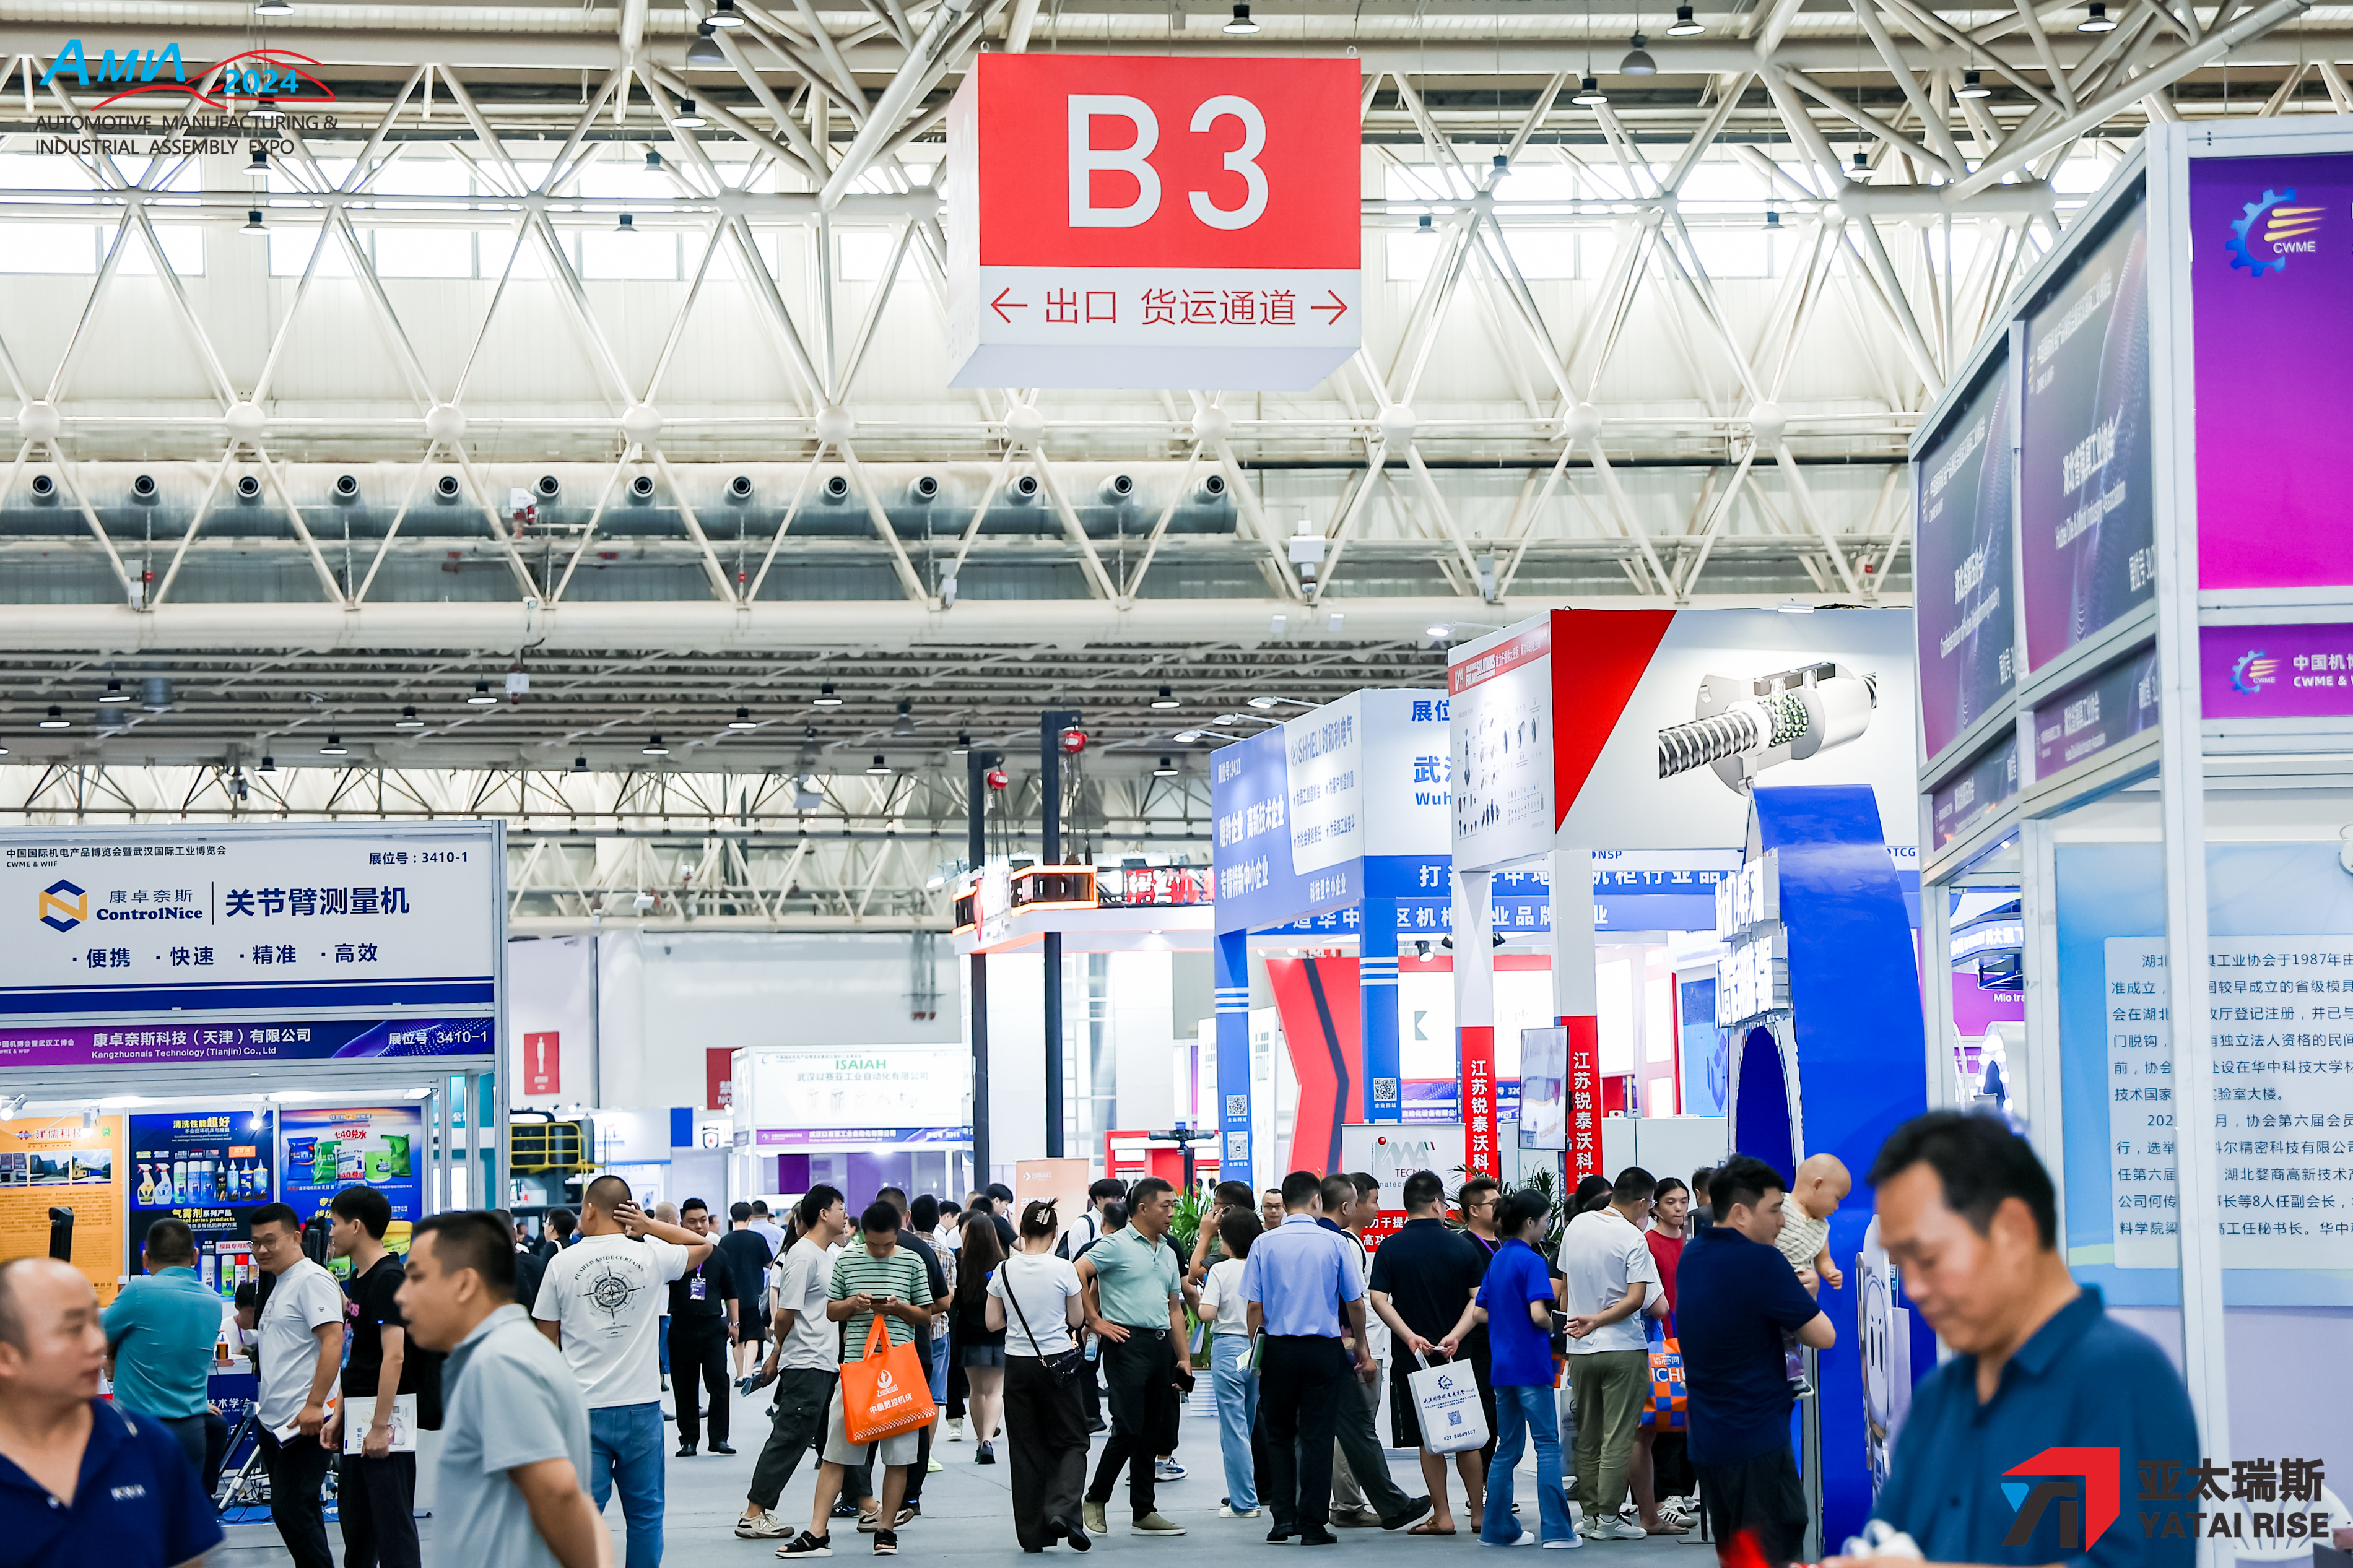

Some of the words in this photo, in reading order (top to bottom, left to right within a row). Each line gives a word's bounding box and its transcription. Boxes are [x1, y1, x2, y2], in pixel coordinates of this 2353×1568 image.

[2273, 241, 2316, 253] CWME
[1046, 288, 1117, 324] 出口
[1141, 288, 1297, 326] 货运通道
[2294, 676, 2333, 687] CWME
[2338, 675, 2347, 686] &
[1414, 755, 1452, 784] 武
[6, 845, 227, 859] 中国国际机电产品博览会暨武汉国际工业博览会
[109, 888, 193, 904] 康卓奈斯
[225, 886, 410, 918] 关节臂测量机
[96, 907, 203, 921] ControlNice
[87, 948, 131, 969] 便携
[170, 946, 214, 967] 快速
[252, 944, 297, 964] 精准
[334, 943, 378, 963] 高效
[0, 1039, 74, 1047] 国机博会暨武汉工博会
[93, 1028, 311, 1048] 康卓奈斯科技（天津）有限公司
[389, 1031, 428, 1046] 展位号
[437, 1031, 487, 1044] 3410-1
[92, 1050, 153, 1060] Kangzhuonais
[155, 1048, 204, 1058] Technology
[206, 1047, 241, 1057] (Tianjin)
[263, 1046, 276, 1054] Ltd
[835, 1059, 887, 1070] ISAIAH
[2115, 1088, 2172, 1101] 技术国家
[2214, 1086, 2283, 1101] 验室大楼。
[1471, 1059, 1490, 1177] 江苏锐泰沃科
[2217, 1194, 2353, 1208] 长等8人任副会长，
[1363, 1234, 1393, 1246] 高功
[575, 1260, 594, 1280] PUSHED
[595, 1255, 614, 1263] ASIDE
[615, 1255, 644, 1273] CURTAINS
